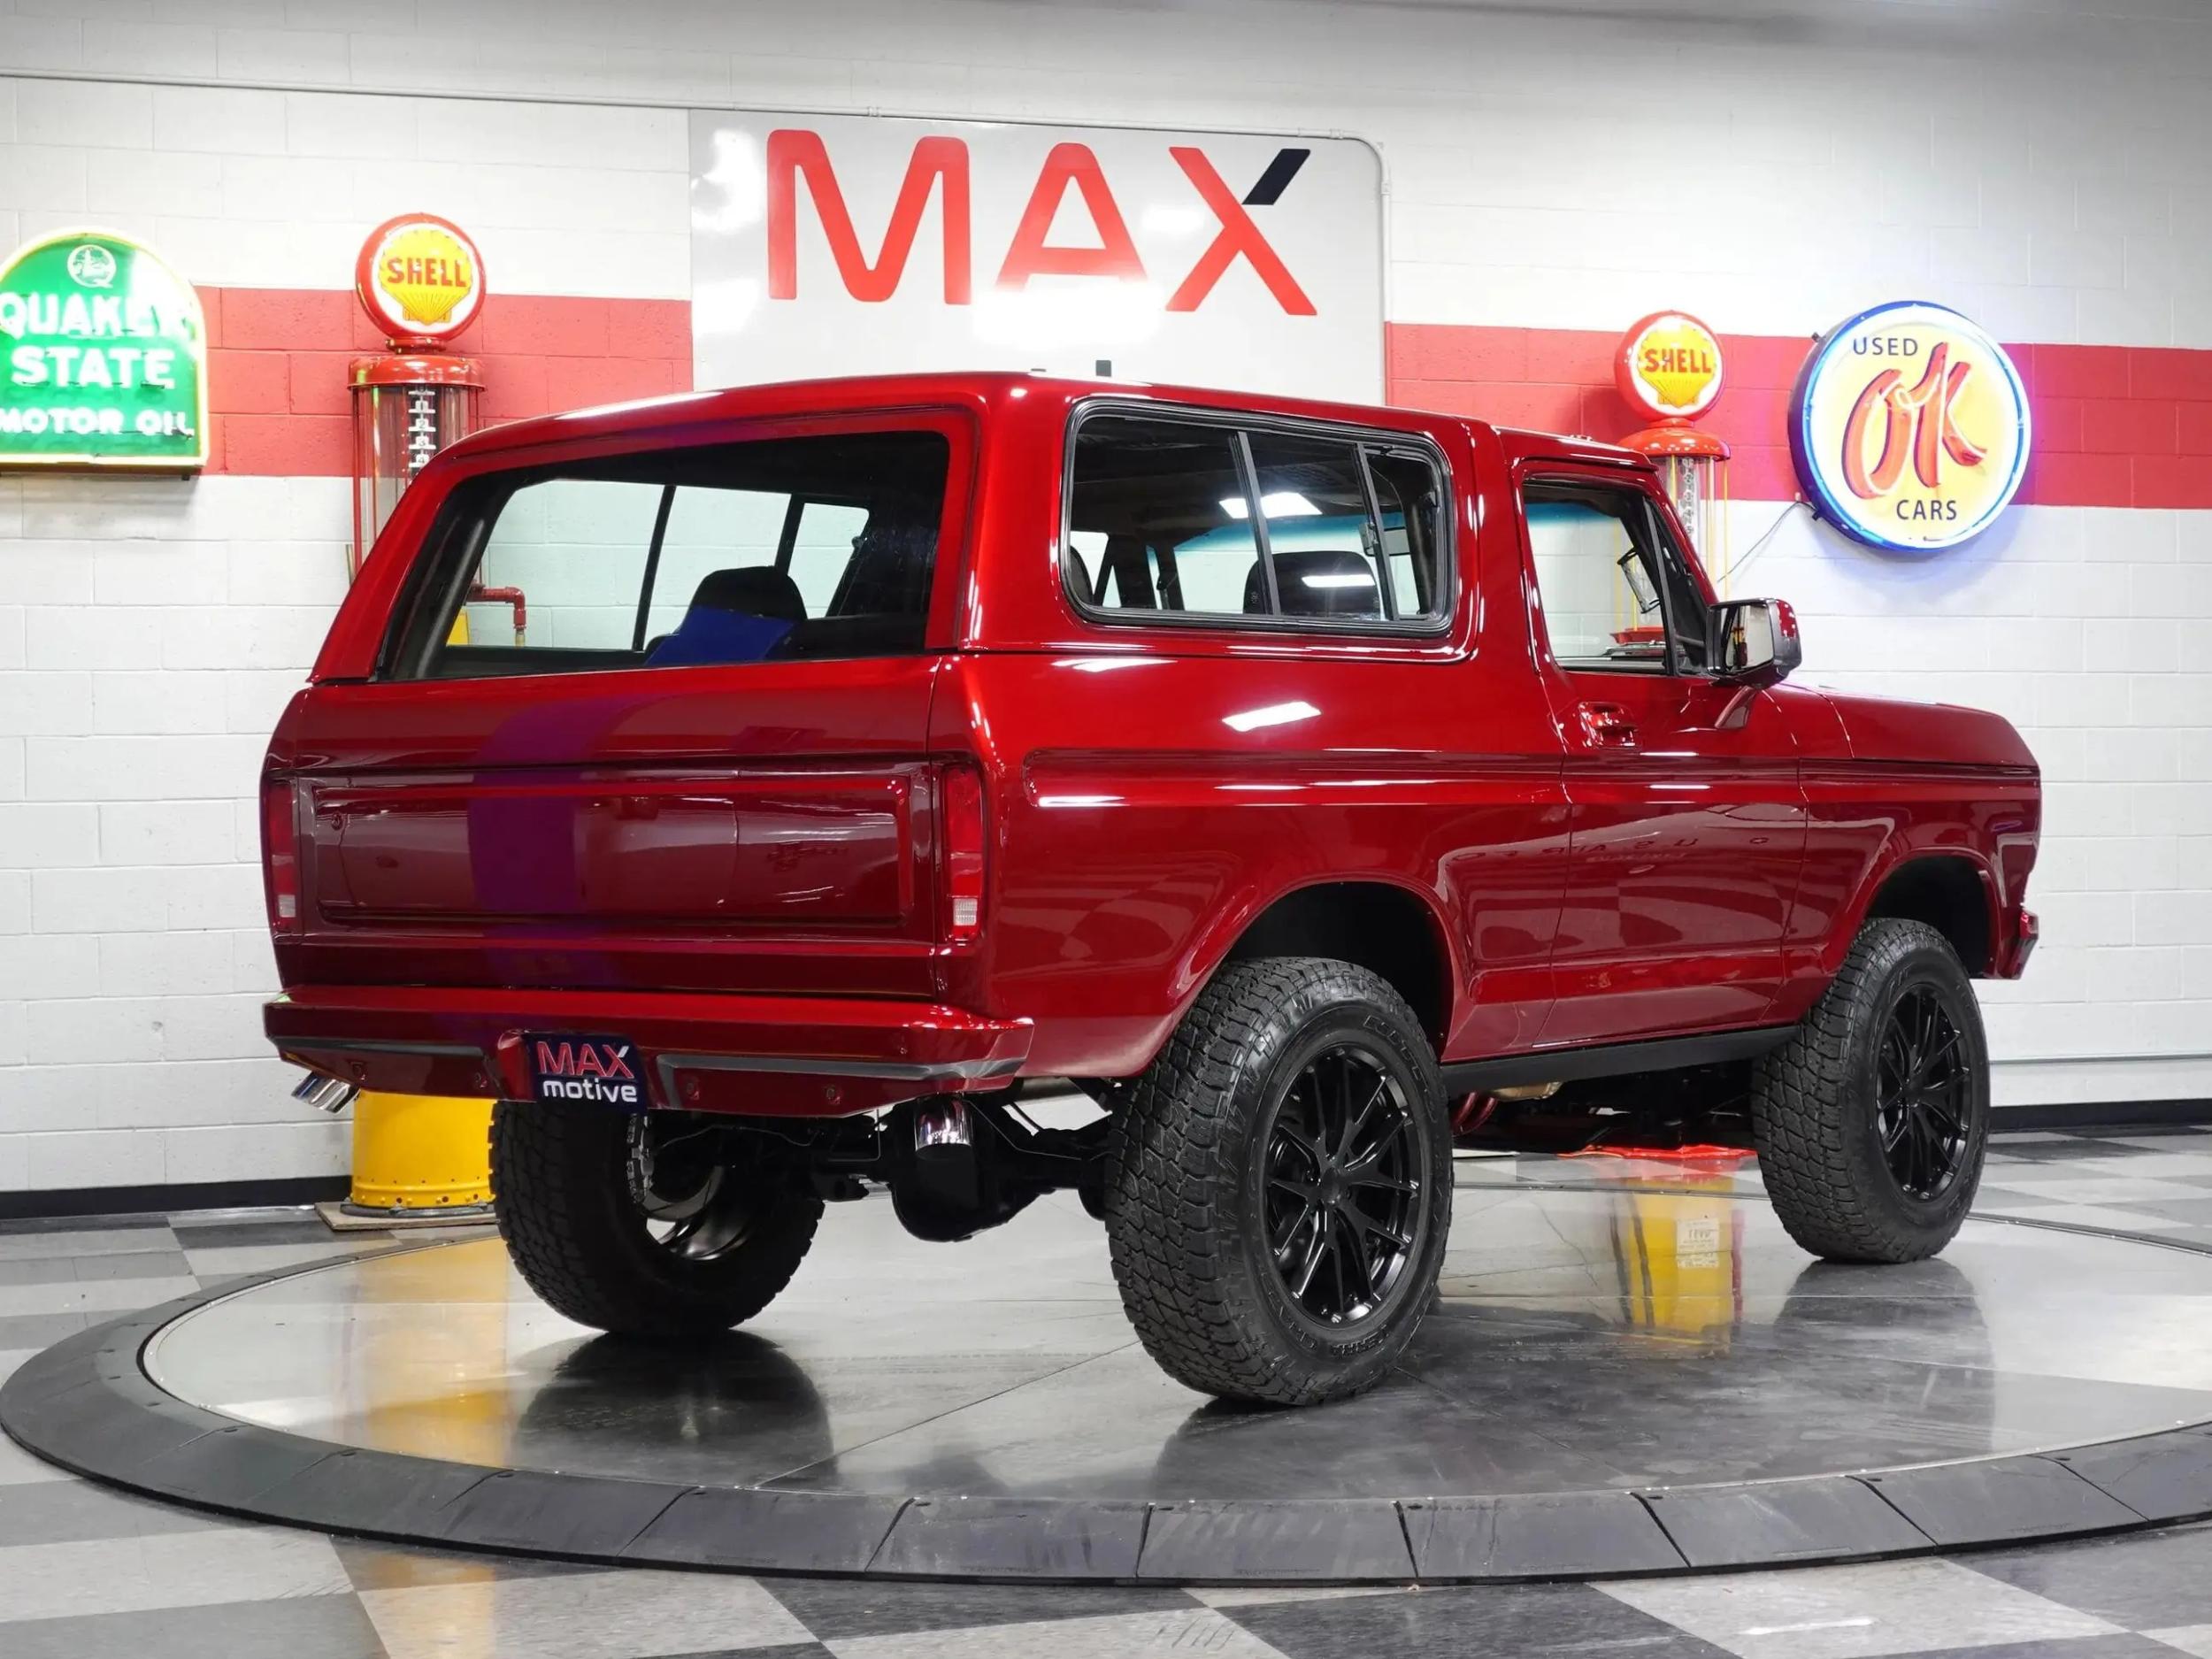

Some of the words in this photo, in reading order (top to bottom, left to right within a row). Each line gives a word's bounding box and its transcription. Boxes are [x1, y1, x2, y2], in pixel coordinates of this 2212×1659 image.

[766, 129, 1318, 316] MAX
[386, 257, 468, 288] SHELL
[1644, 347, 1713, 373] SHELL
[1853, 336, 1918, 357] USED
[11, 344, 176, 389] STATE
[0, 407, 125, 435] MOTOR
[135, 409, 196, 437] OIL
[1841, 342, 1988, 501] OK
[1896, 499, 1957, 520] CARS
[536, 1041, 635, 1079] MAX
[542, 1077, 638, 1103] motive
